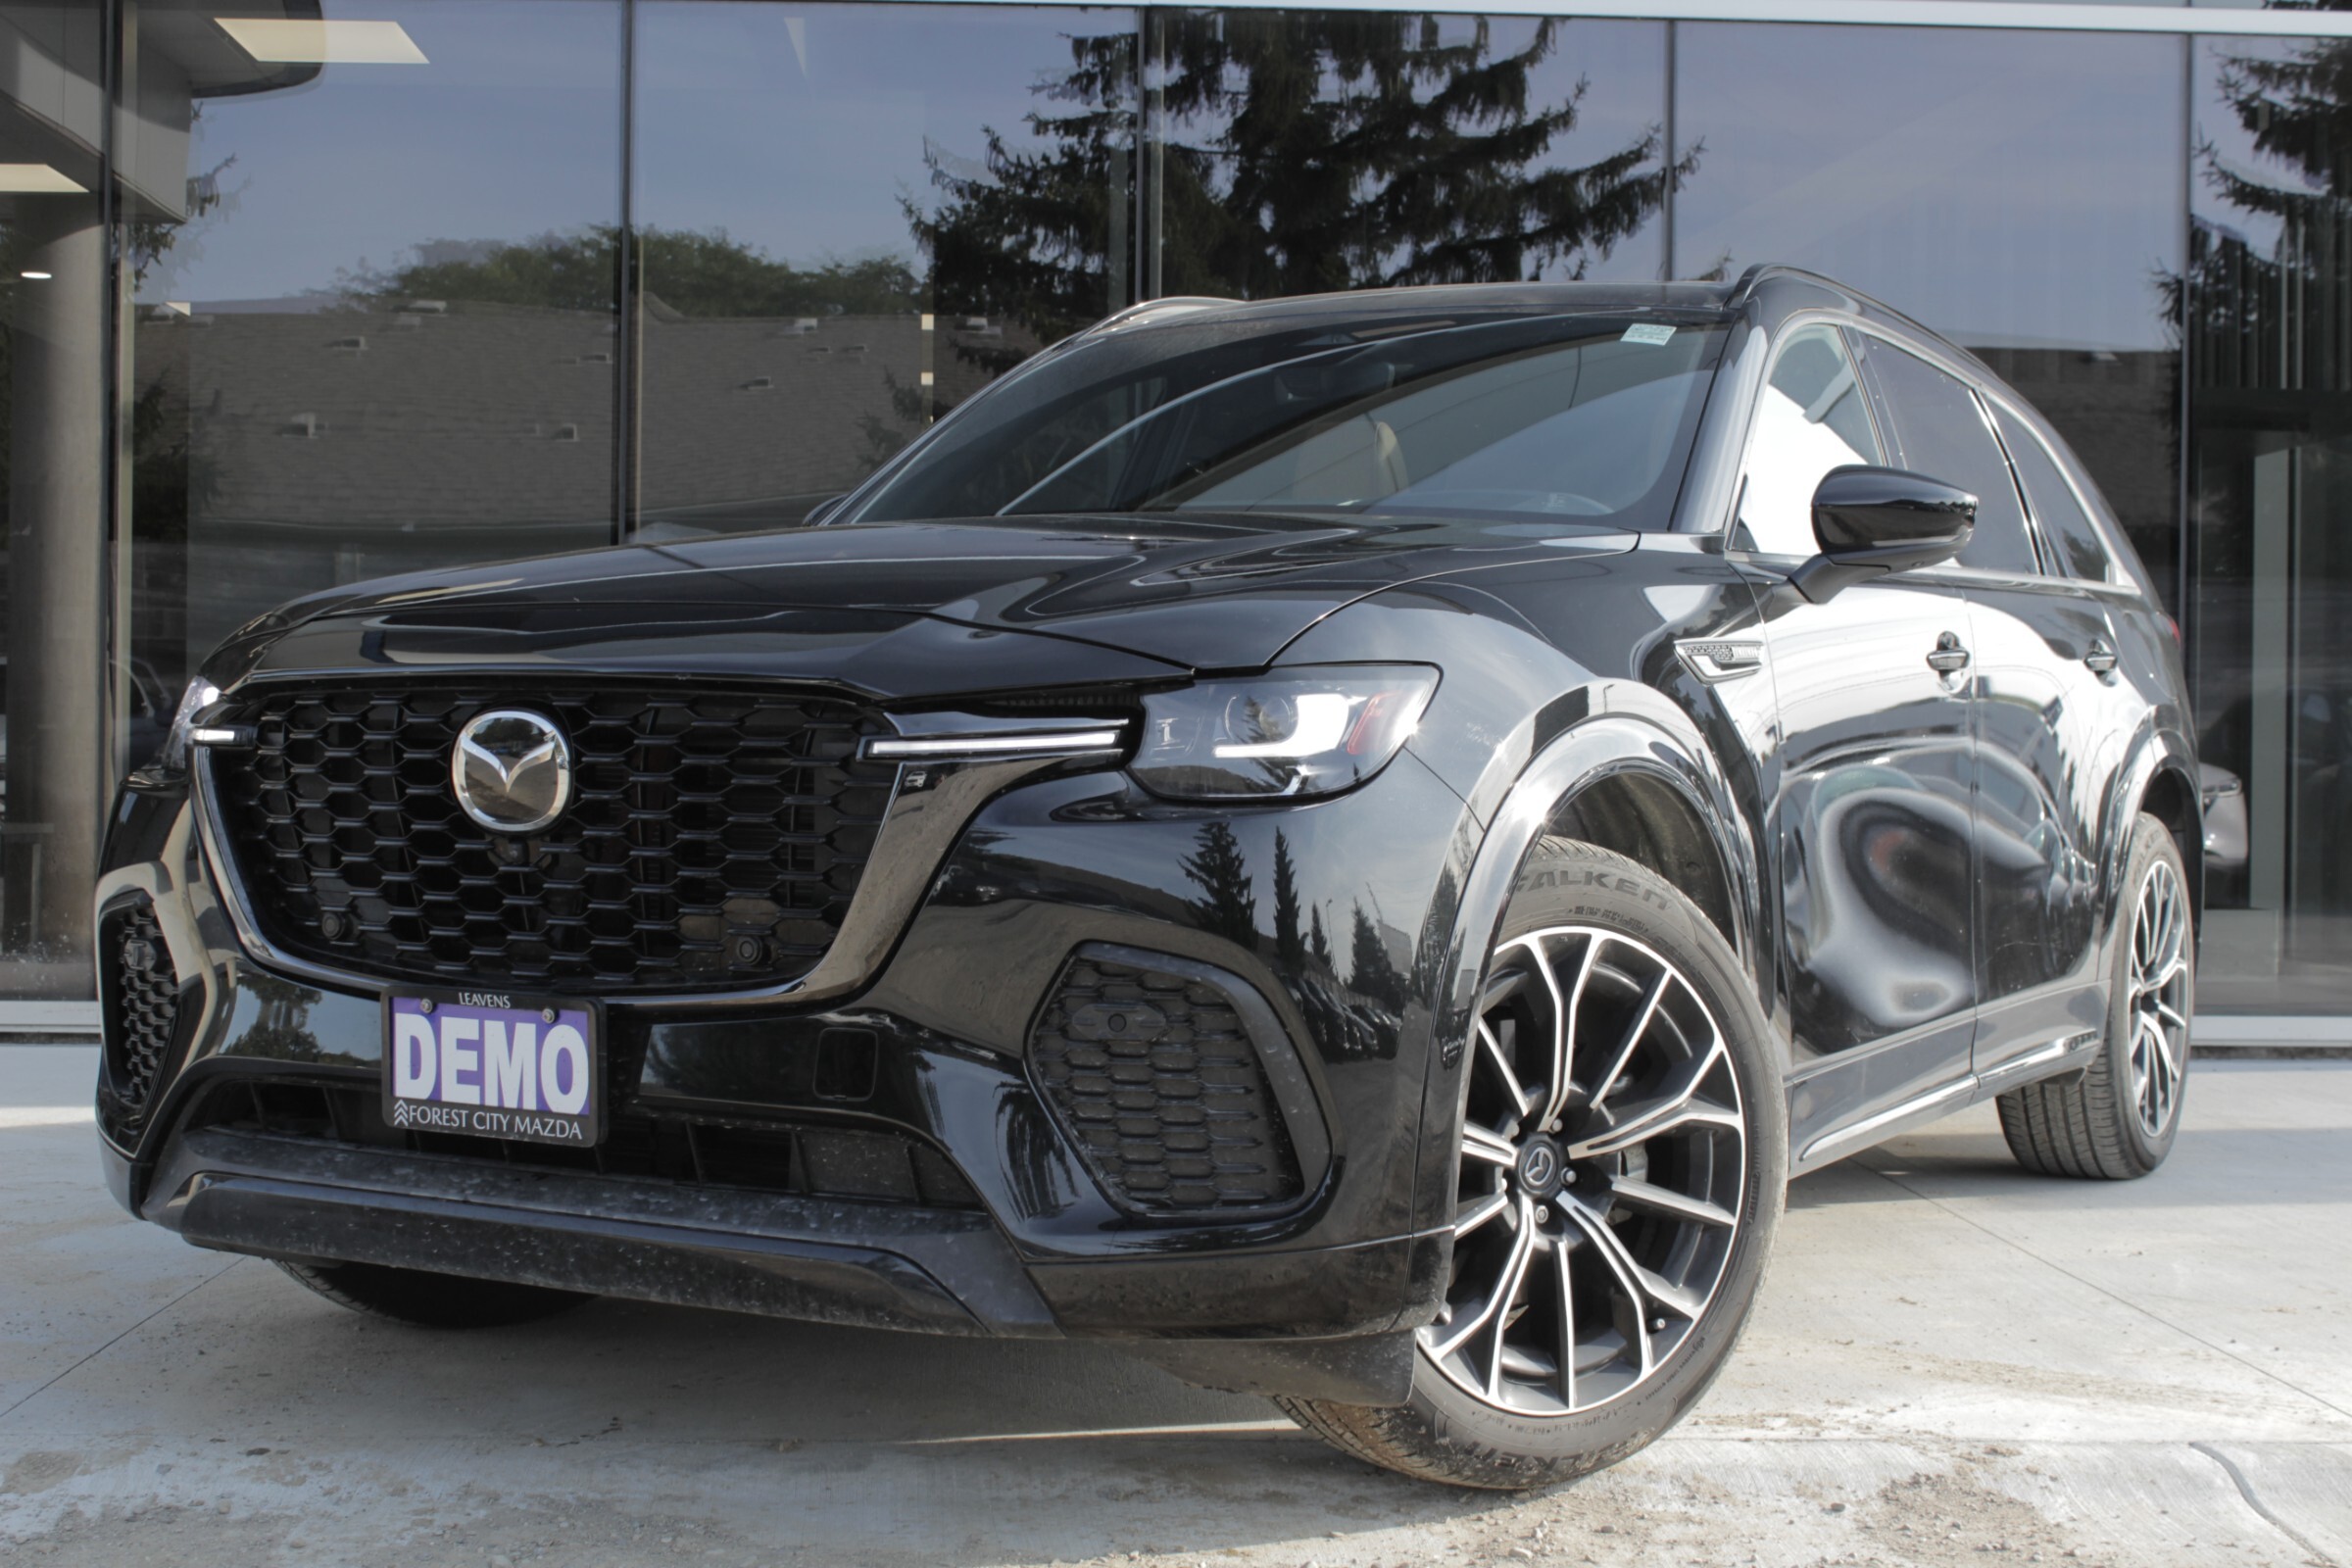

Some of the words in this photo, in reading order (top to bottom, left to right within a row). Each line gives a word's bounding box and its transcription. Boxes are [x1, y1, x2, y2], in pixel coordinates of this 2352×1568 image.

[459, 992, 511, 1008] LEAVENS
[394, 1012, 589, 1115] DEMO
[409, 1104, 468, 1128] FOREST
[472, 1111, 510, 1132] CITY
[514, 1116, 582, 1140] MAZDA
